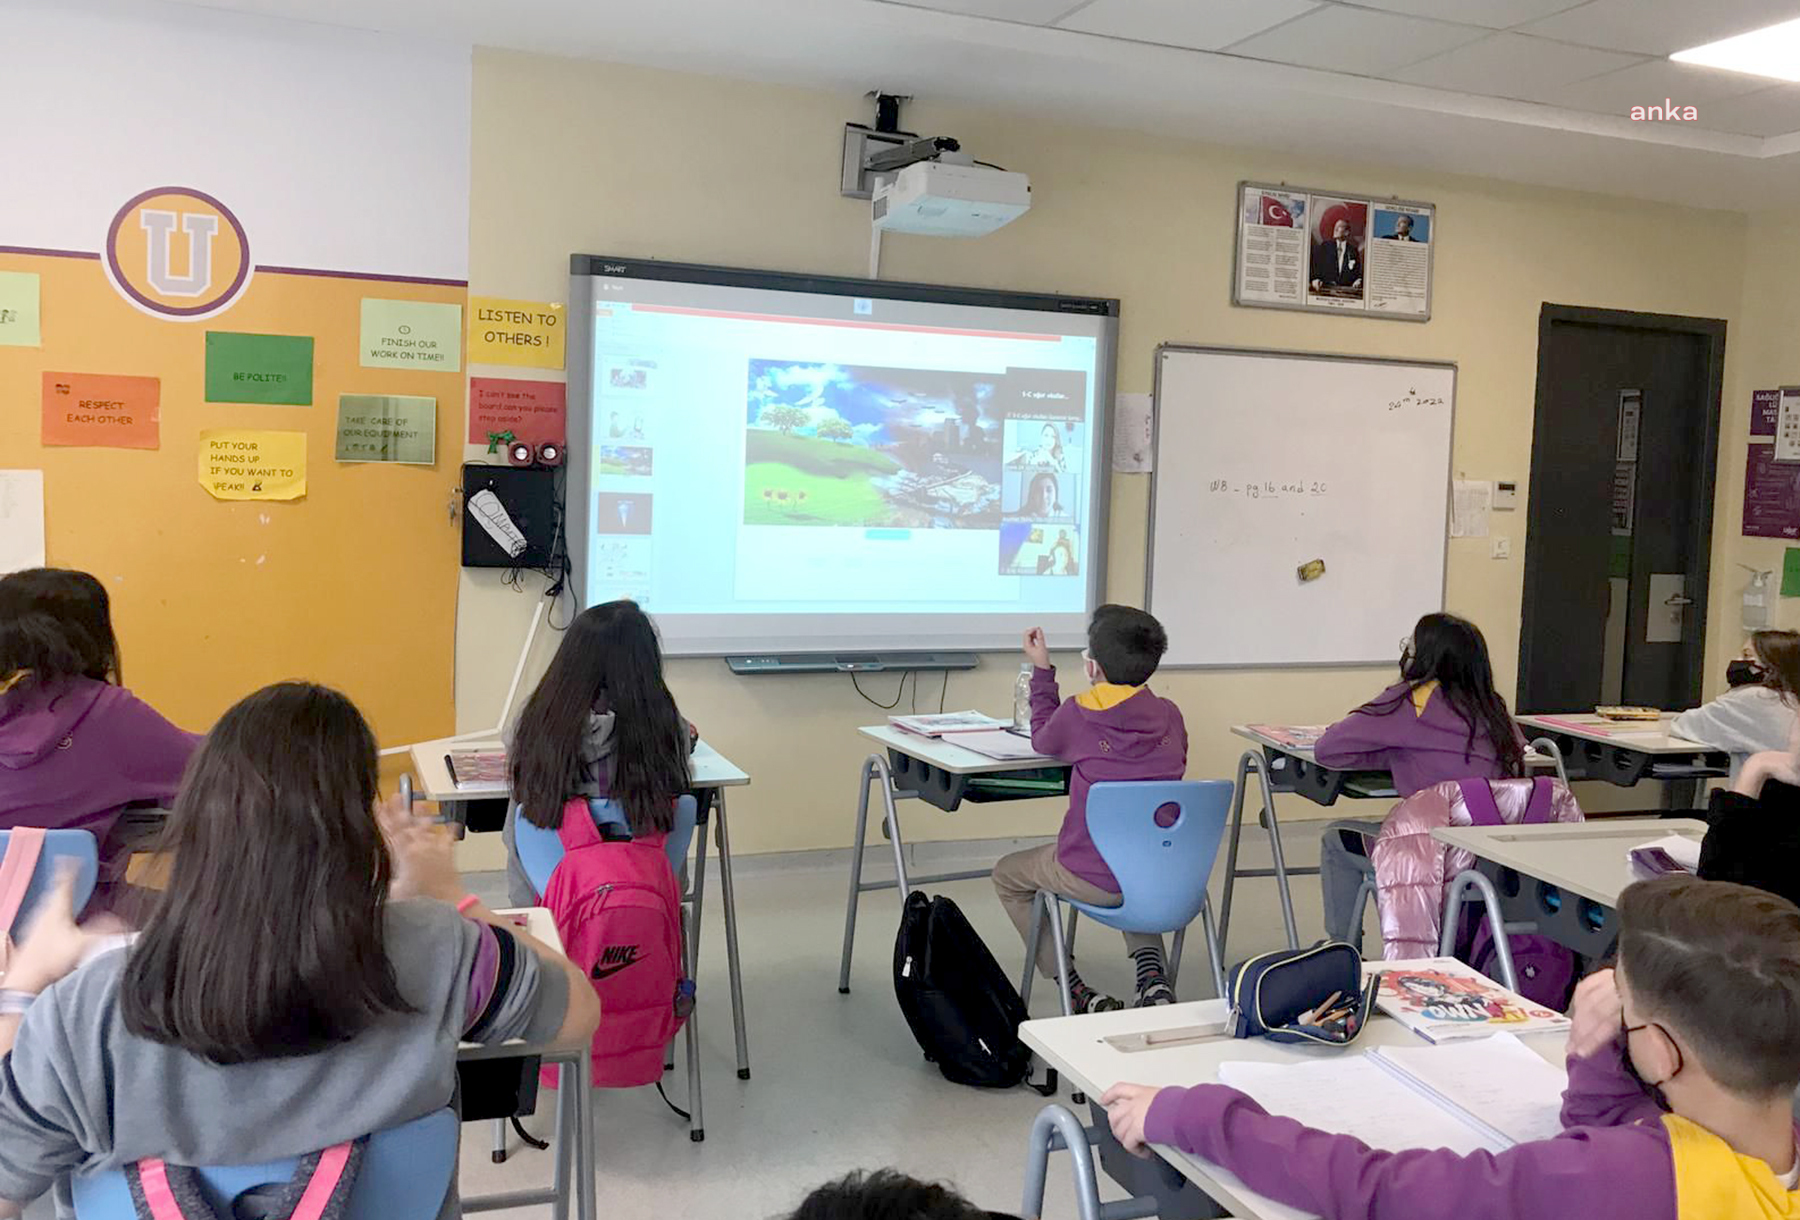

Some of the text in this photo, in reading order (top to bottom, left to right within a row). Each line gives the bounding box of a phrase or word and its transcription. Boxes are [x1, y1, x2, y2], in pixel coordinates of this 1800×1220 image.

[140, 208, 218, 297] U
[478, 308, 557, 327] LISTEN TO
[381, 337, 438, 349] FINISH OUR
[484, 330, 542, 347] OTHERS
[370, 349, 398, 359] WORK
[399, 351, 415, 360] ON
[233, 371, 246, 381] BE
[78, 399, 126, 411] RESPECT
[66, 413, 134, 425] EACH OTHER
[344, 416, 408, 426] TAKE CARE OF
[343, 428, 419, 439] OUR EQUIPMENT
[210, 440, 258, 451] PUT YOUR
[210, 454, 260, 464] HANDS UP
[210, 466, 294, 478] IF YOU WANT TO
[1246, 483, 1260, 499] pg
[1281, 480, 1304, 494] and
[600, 944, 640, 965] NIKE
